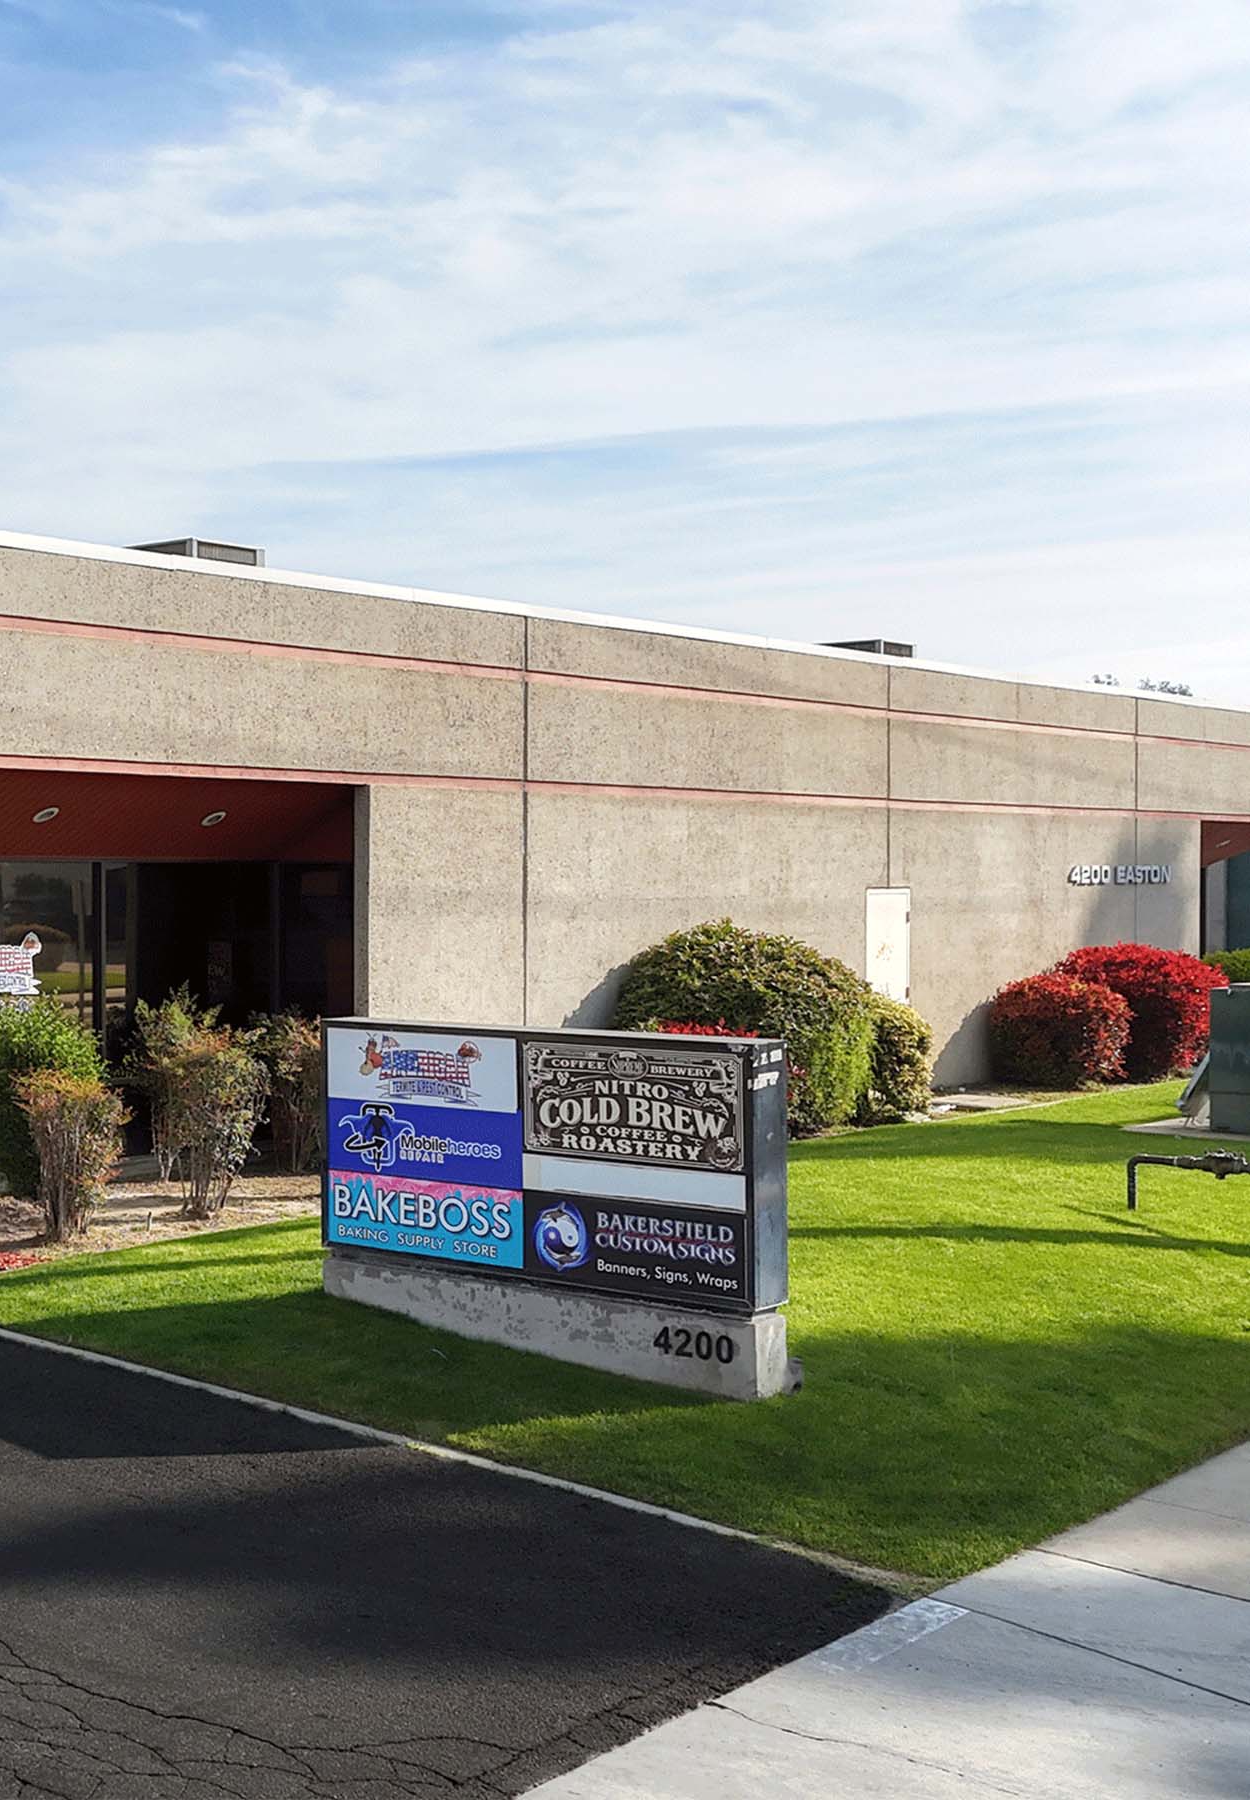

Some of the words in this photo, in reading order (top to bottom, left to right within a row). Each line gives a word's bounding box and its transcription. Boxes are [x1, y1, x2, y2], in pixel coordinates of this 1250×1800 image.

[1068, 864, 1111, 885] 4200
[1115, 864, 1172, 885] EASTON
[551, 1058, 607, 1071] COFFEE
[650, 1065, 713, 1078] BREWERY
[392, 1080, 416, 1093] TERMITE
[422, 1081, 437, 1096] PEST
[437, 1084, 464, 1099] CONTROL
[594, 1080, 669, 1100] NITRO
[539, 1097, 621, 1129] COLD
[627, 1097, 727, 1140] BREW
[400, 1134, 501, 1159] Mobileheroes
[595, 1125, 668, 1142] COFFEE
[400, 1149, 445, 1164] REPAIR
[561, 1133, 703, 1161] ROASTERY
[334, 1184, 511, 1239] BAKEBOSS
[596, 1211, 734, 1243] BAKERSFIELD
[338, 1224, 389, 1243] BAKING
[397, 1232, 445, 1249] SUPPLY
[453, 1240, 497, 1258] STORE
[595, 1232, 677, 1260] CUSTOM
[677, 1243, 736, 1265] SIGNS
[597, 1259, 650, 1280] Banners,
[654, 1266, 693, 1285] Signs,
[696, 1271, 738, 1290] Wraps
[653, 1326, 735, 1364] 4200
